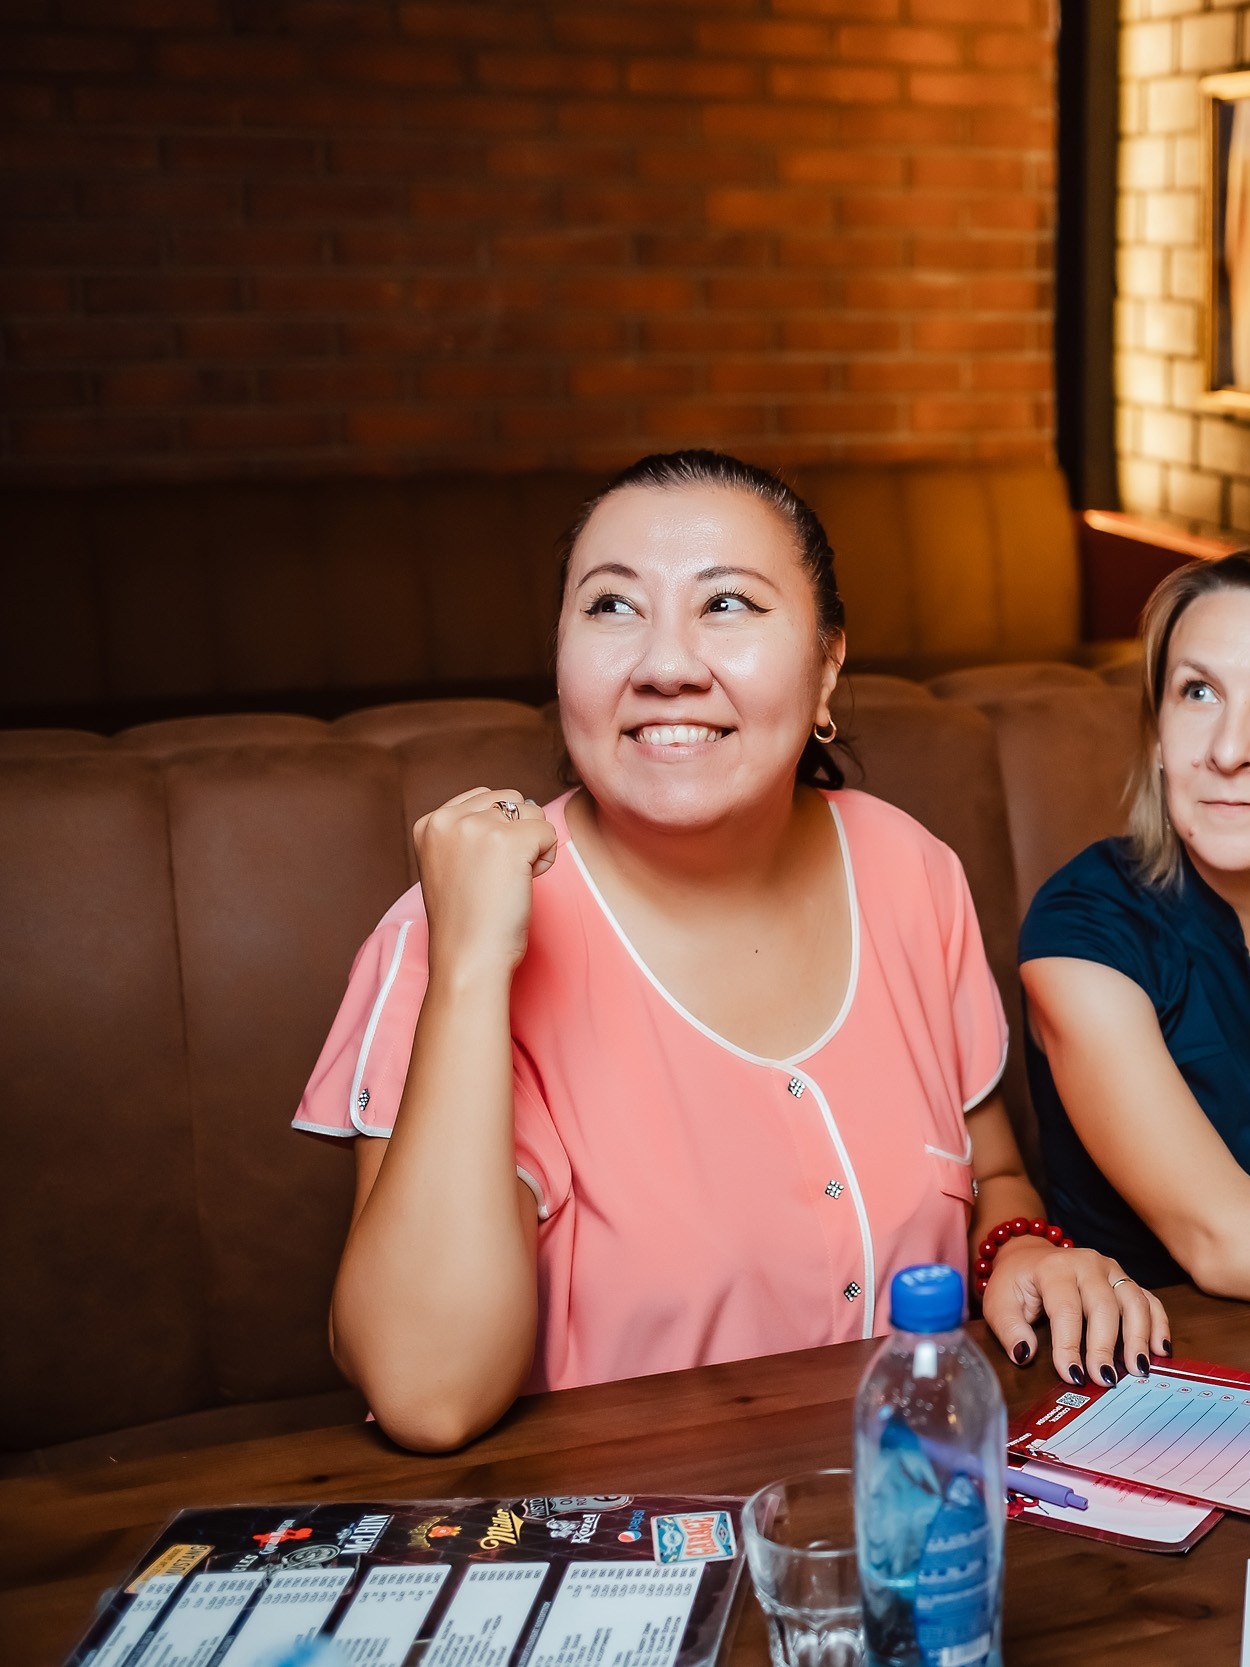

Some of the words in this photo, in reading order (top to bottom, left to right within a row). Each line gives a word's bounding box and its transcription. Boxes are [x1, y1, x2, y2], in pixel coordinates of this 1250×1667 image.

[480, 1508, 517, 1550] Miller
[571, 1514, 597, 1544] Kozel
[628, 1509, 646, 1533] pepsi
[681, 1516, 719, 1557] GARAGE
